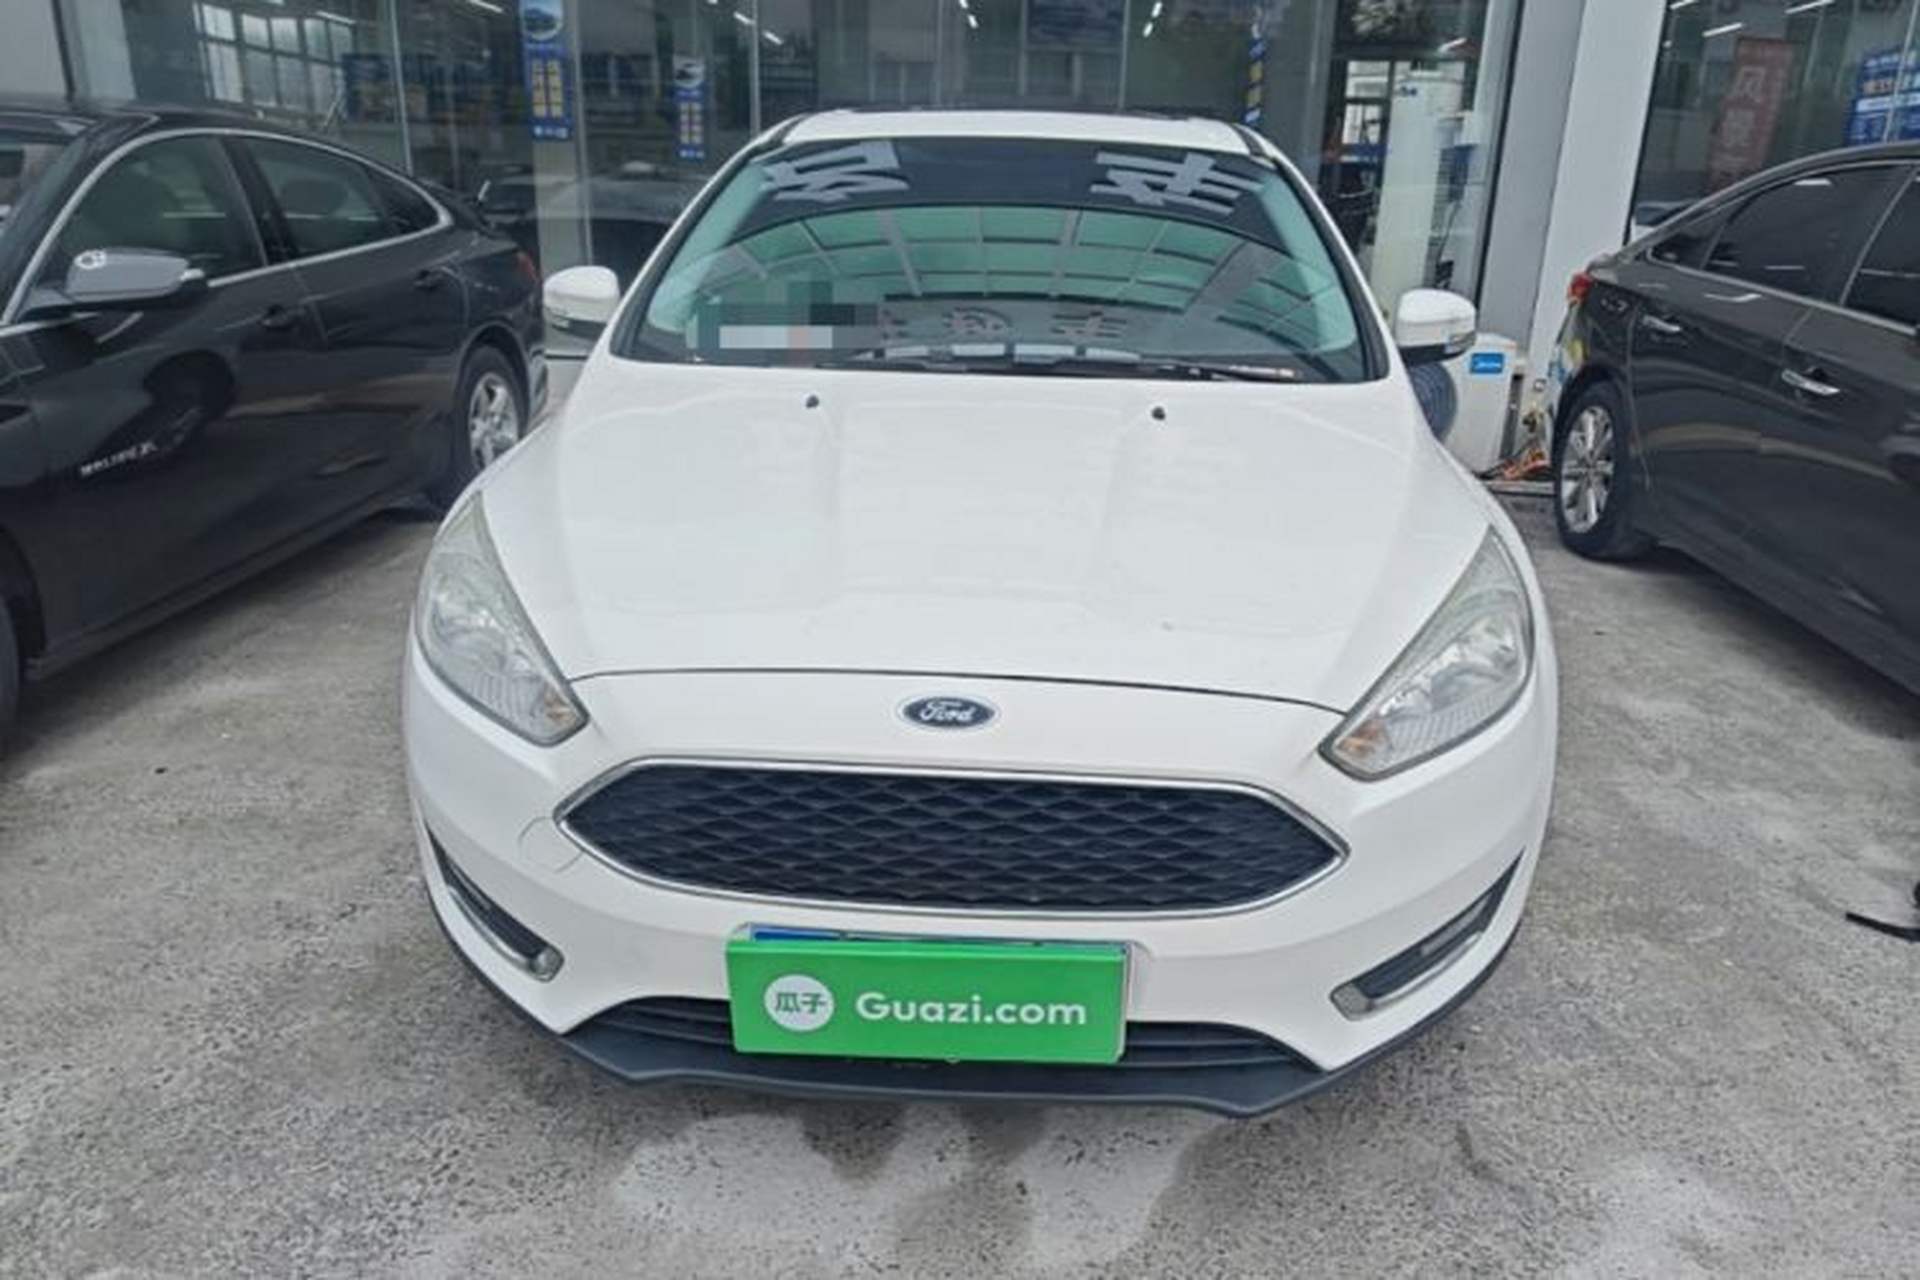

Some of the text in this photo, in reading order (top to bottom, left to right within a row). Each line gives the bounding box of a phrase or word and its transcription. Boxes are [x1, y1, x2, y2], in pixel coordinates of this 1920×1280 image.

[920, 701, 976, 721] Ford
[775, 991, 1087, 1026] 瓜子 Guazi.com
